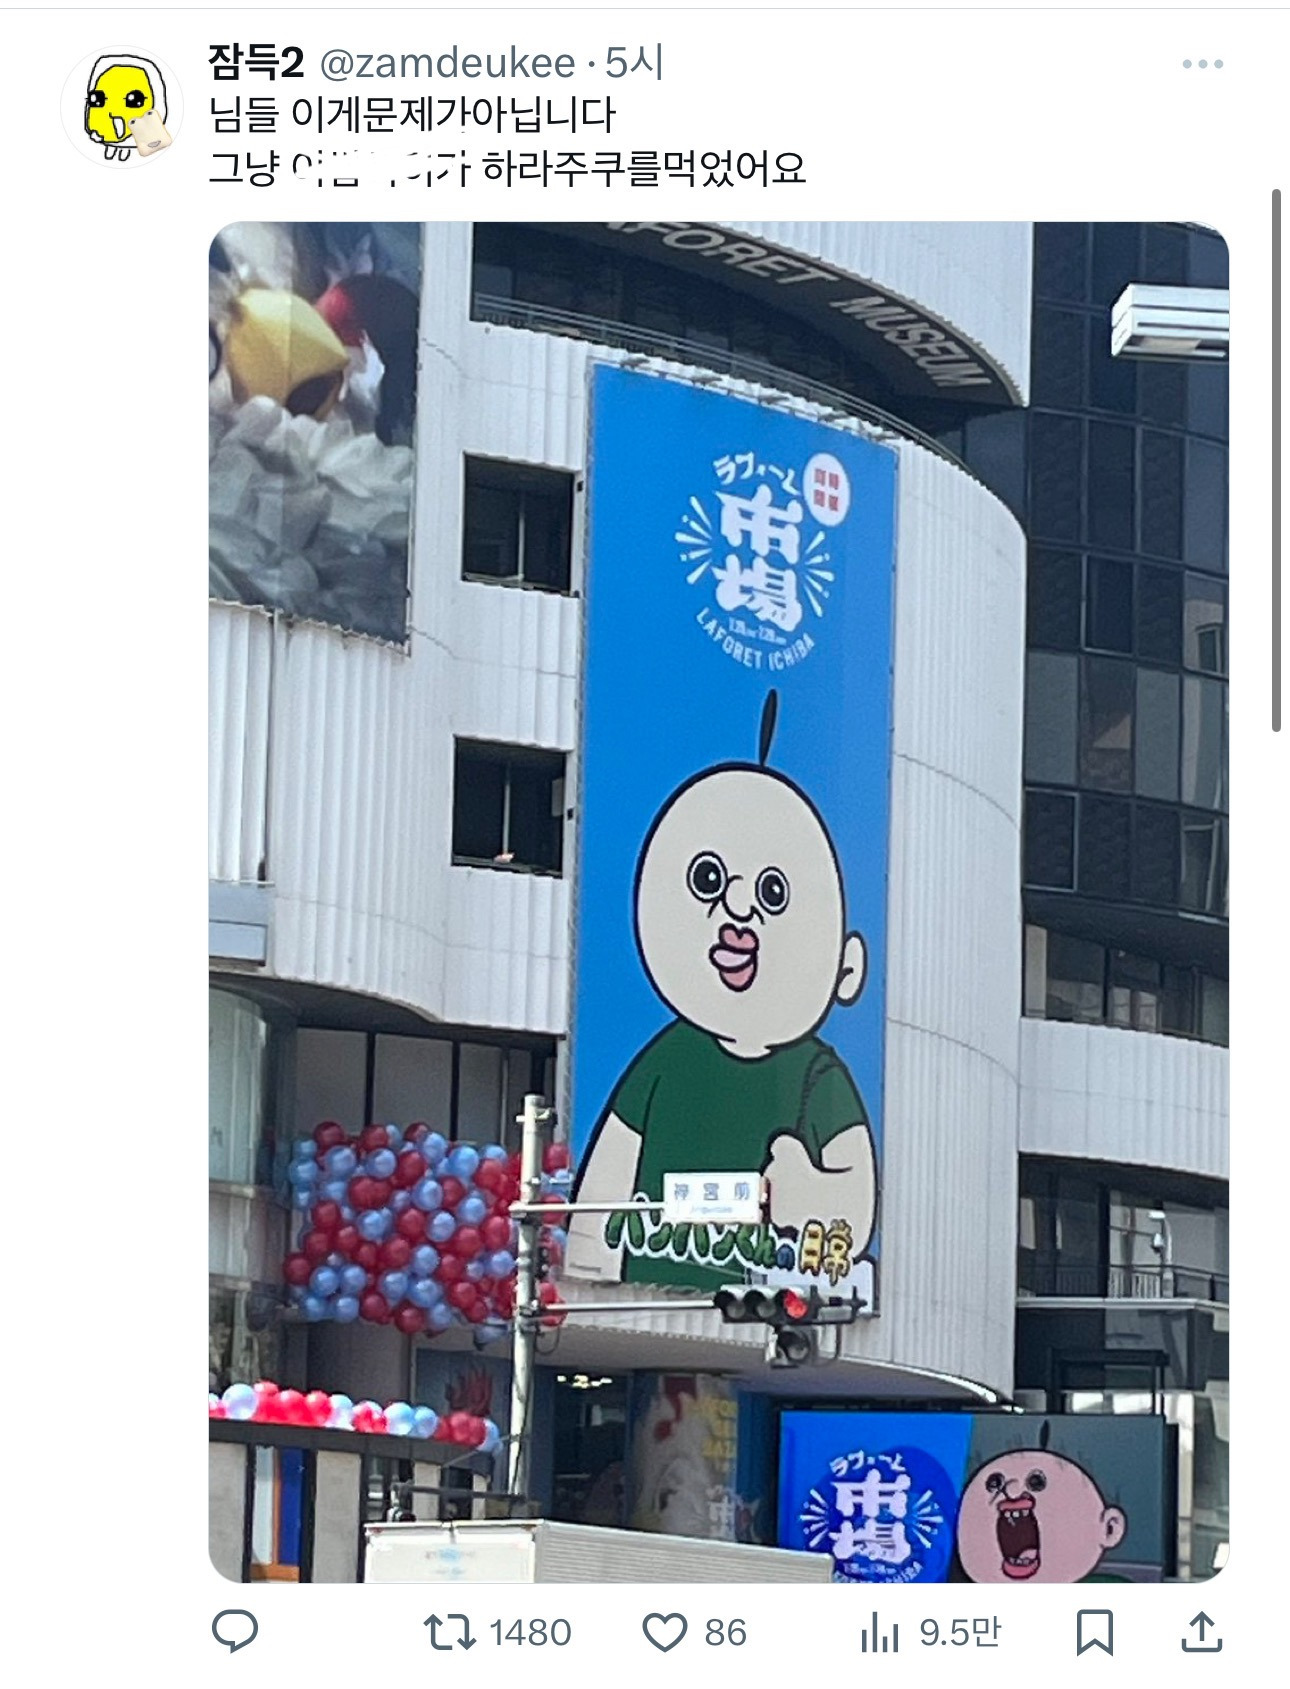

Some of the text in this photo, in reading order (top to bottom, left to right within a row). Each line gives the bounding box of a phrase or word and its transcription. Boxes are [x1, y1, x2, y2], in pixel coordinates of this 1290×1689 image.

[607, 222, 992, 387] FORET MUSEUM
[712, 484, 803, 632] 市場
[696, 607, 762, 670] LAFORET
[768, 632, 815, 672] ICHIBA
[828, 1468, 912, 1565] 市場
